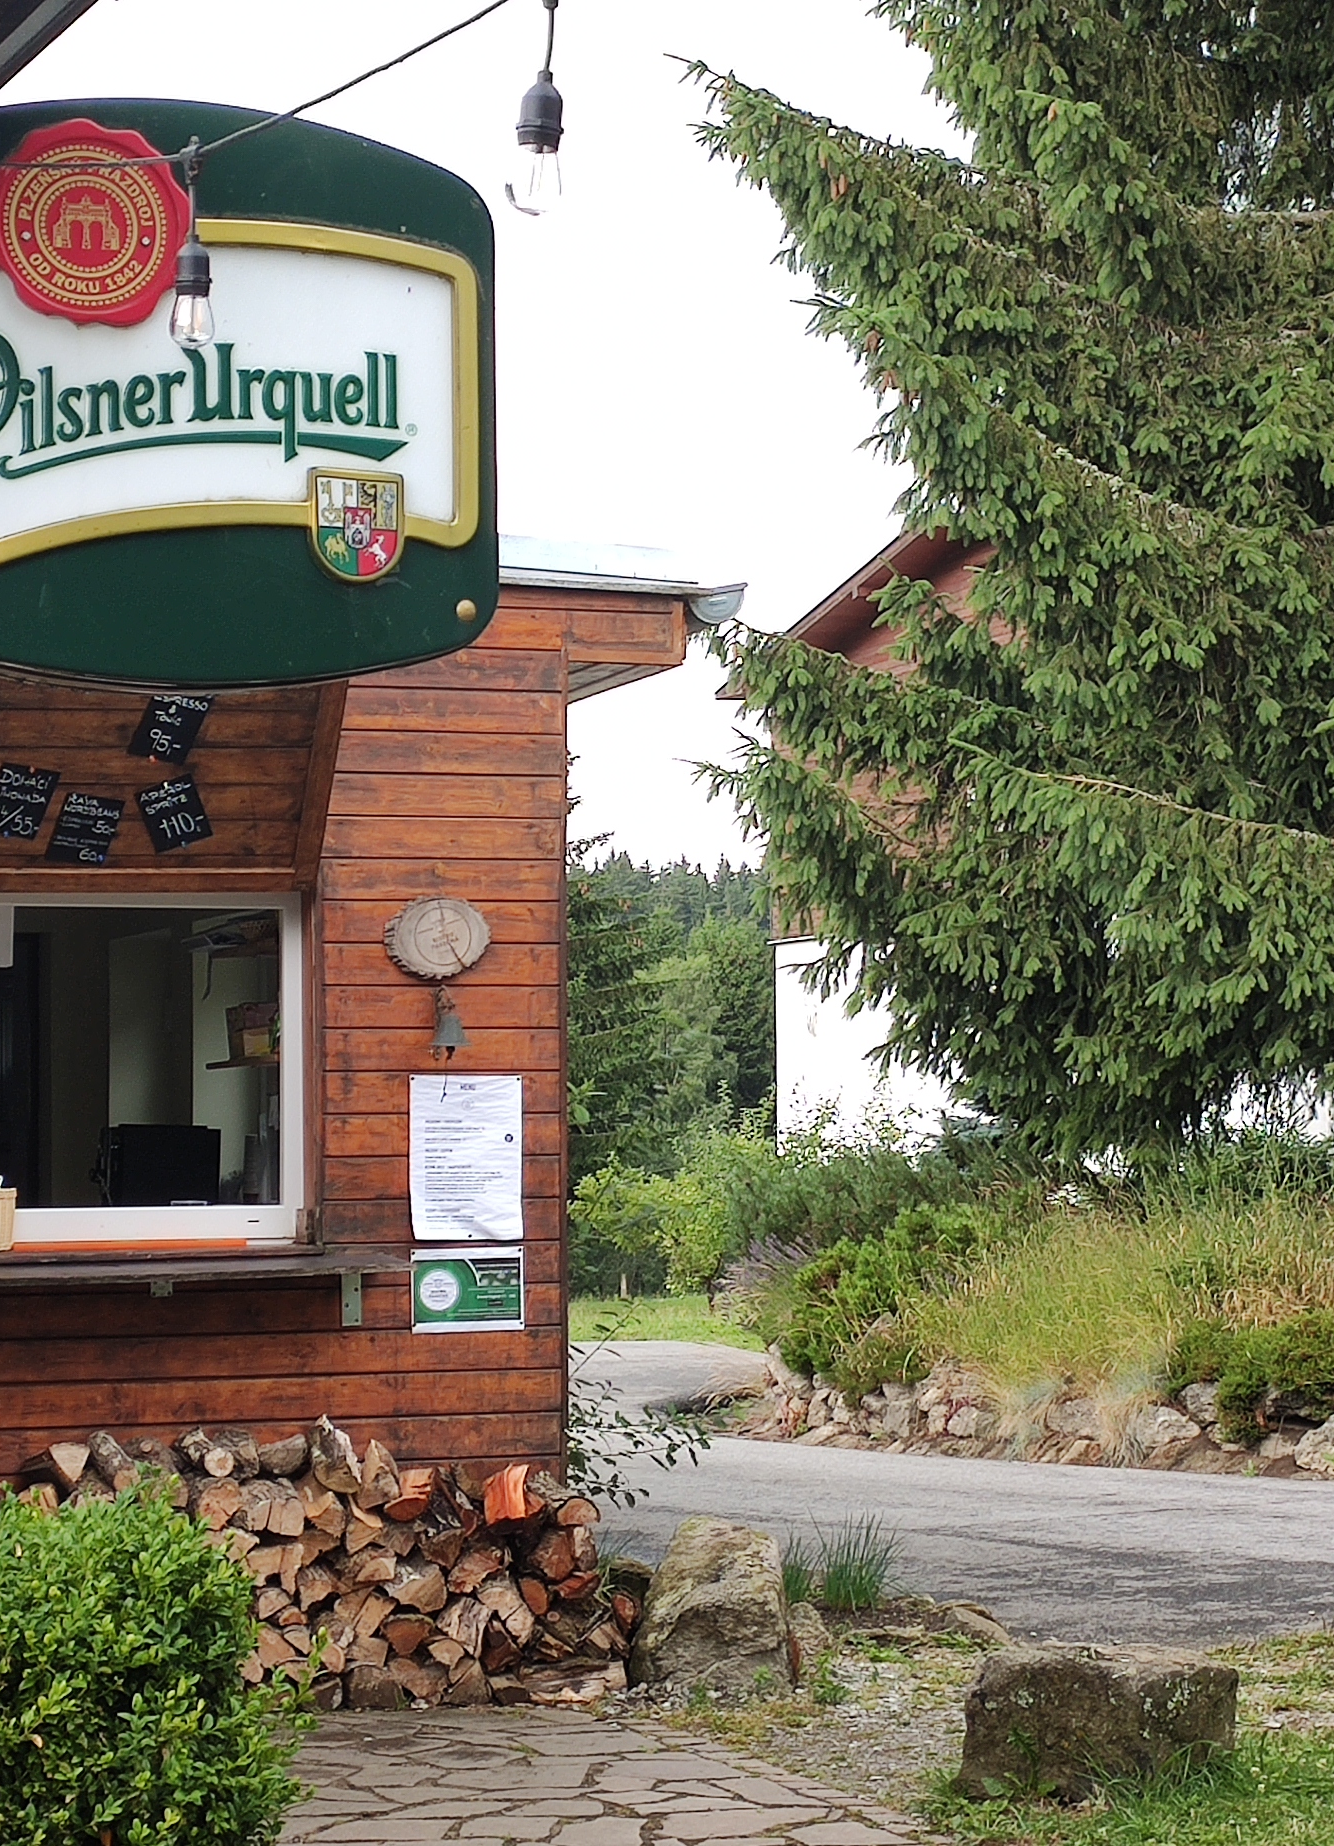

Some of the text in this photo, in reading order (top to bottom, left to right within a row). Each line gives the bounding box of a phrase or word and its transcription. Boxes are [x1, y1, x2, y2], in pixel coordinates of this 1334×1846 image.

[29, 253, 143, 294] OD ROKU 1842
[183, 342, 400, 463] Urquell
[149, 728, 181, 756] 95,-
